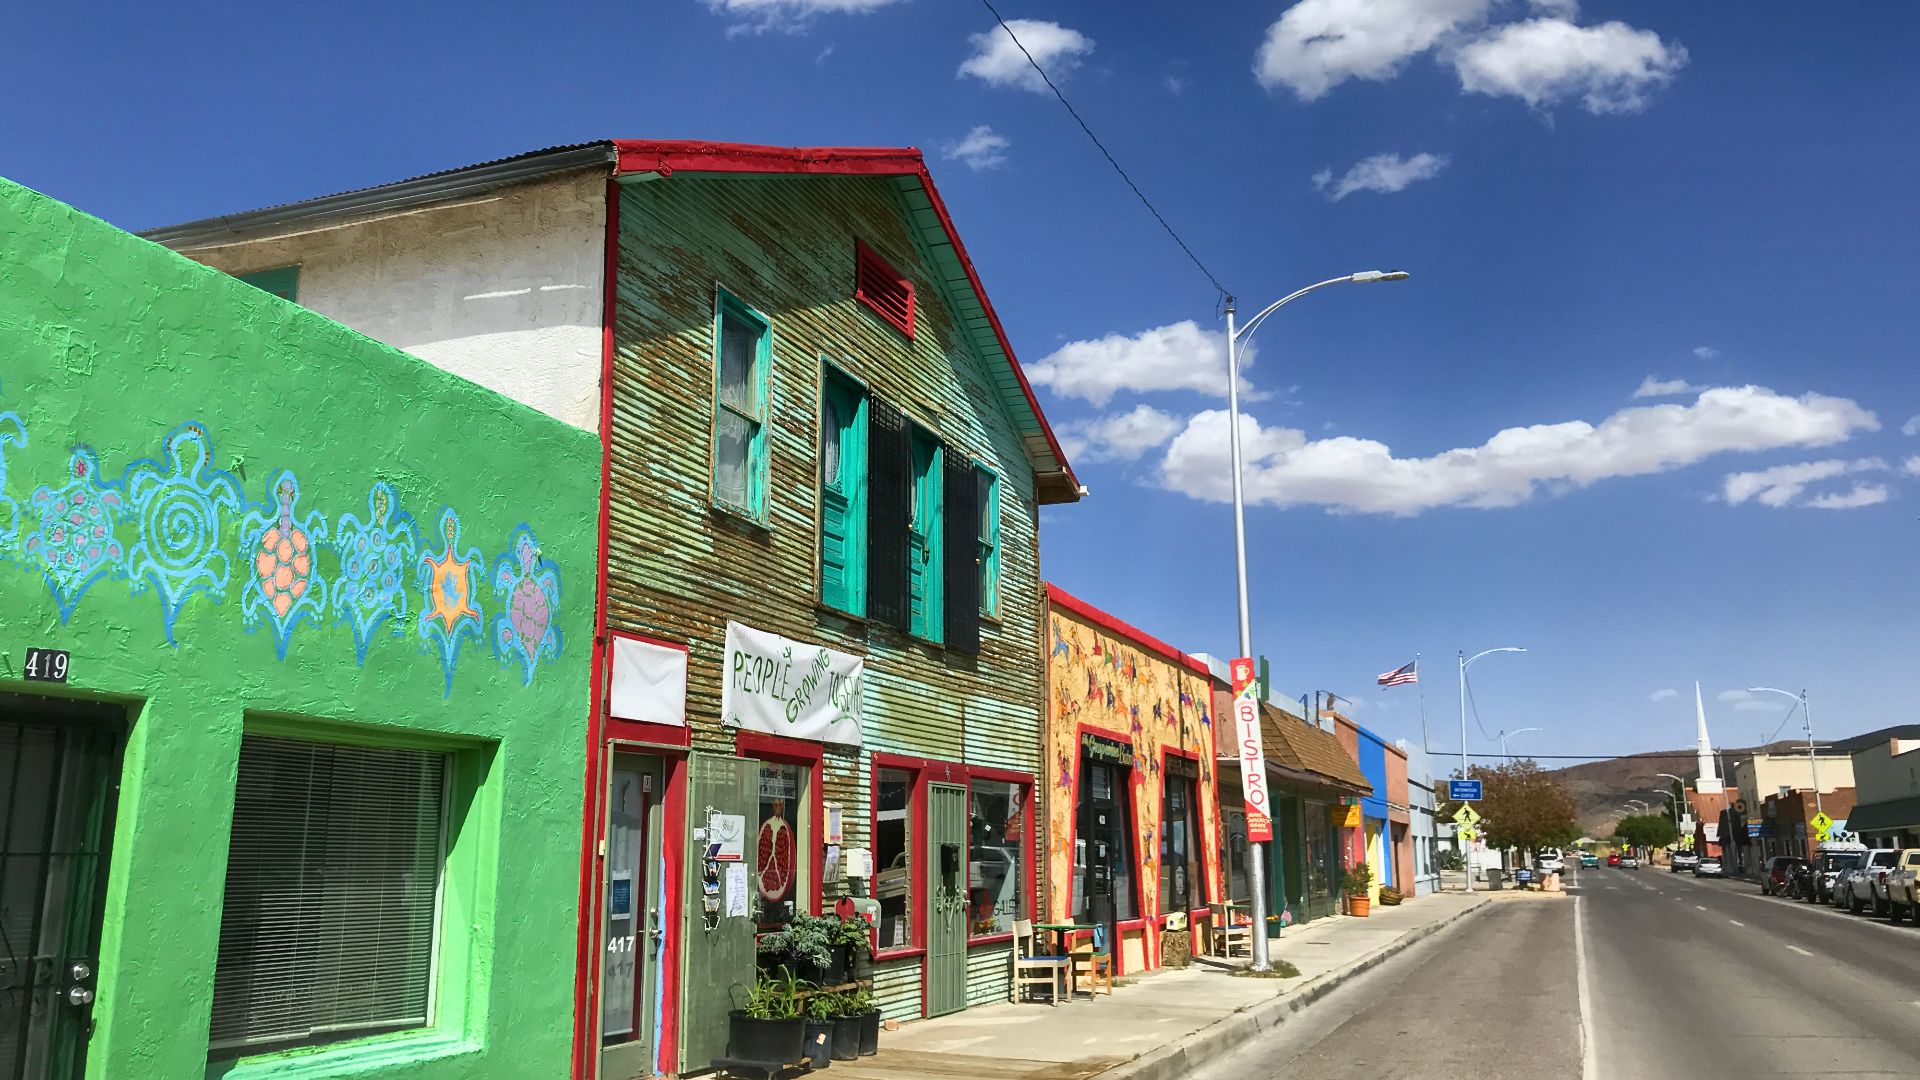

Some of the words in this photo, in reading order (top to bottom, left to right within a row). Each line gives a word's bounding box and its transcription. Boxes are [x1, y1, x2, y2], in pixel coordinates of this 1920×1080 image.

[26, 652, 67, 678] 419
[733, 650, 791, 701] PEOPLE
[786, 648, 830, 723] GROWING
[1240, 706, 1265, 805] BISTRO
[608, 936, 634, 953] 417
